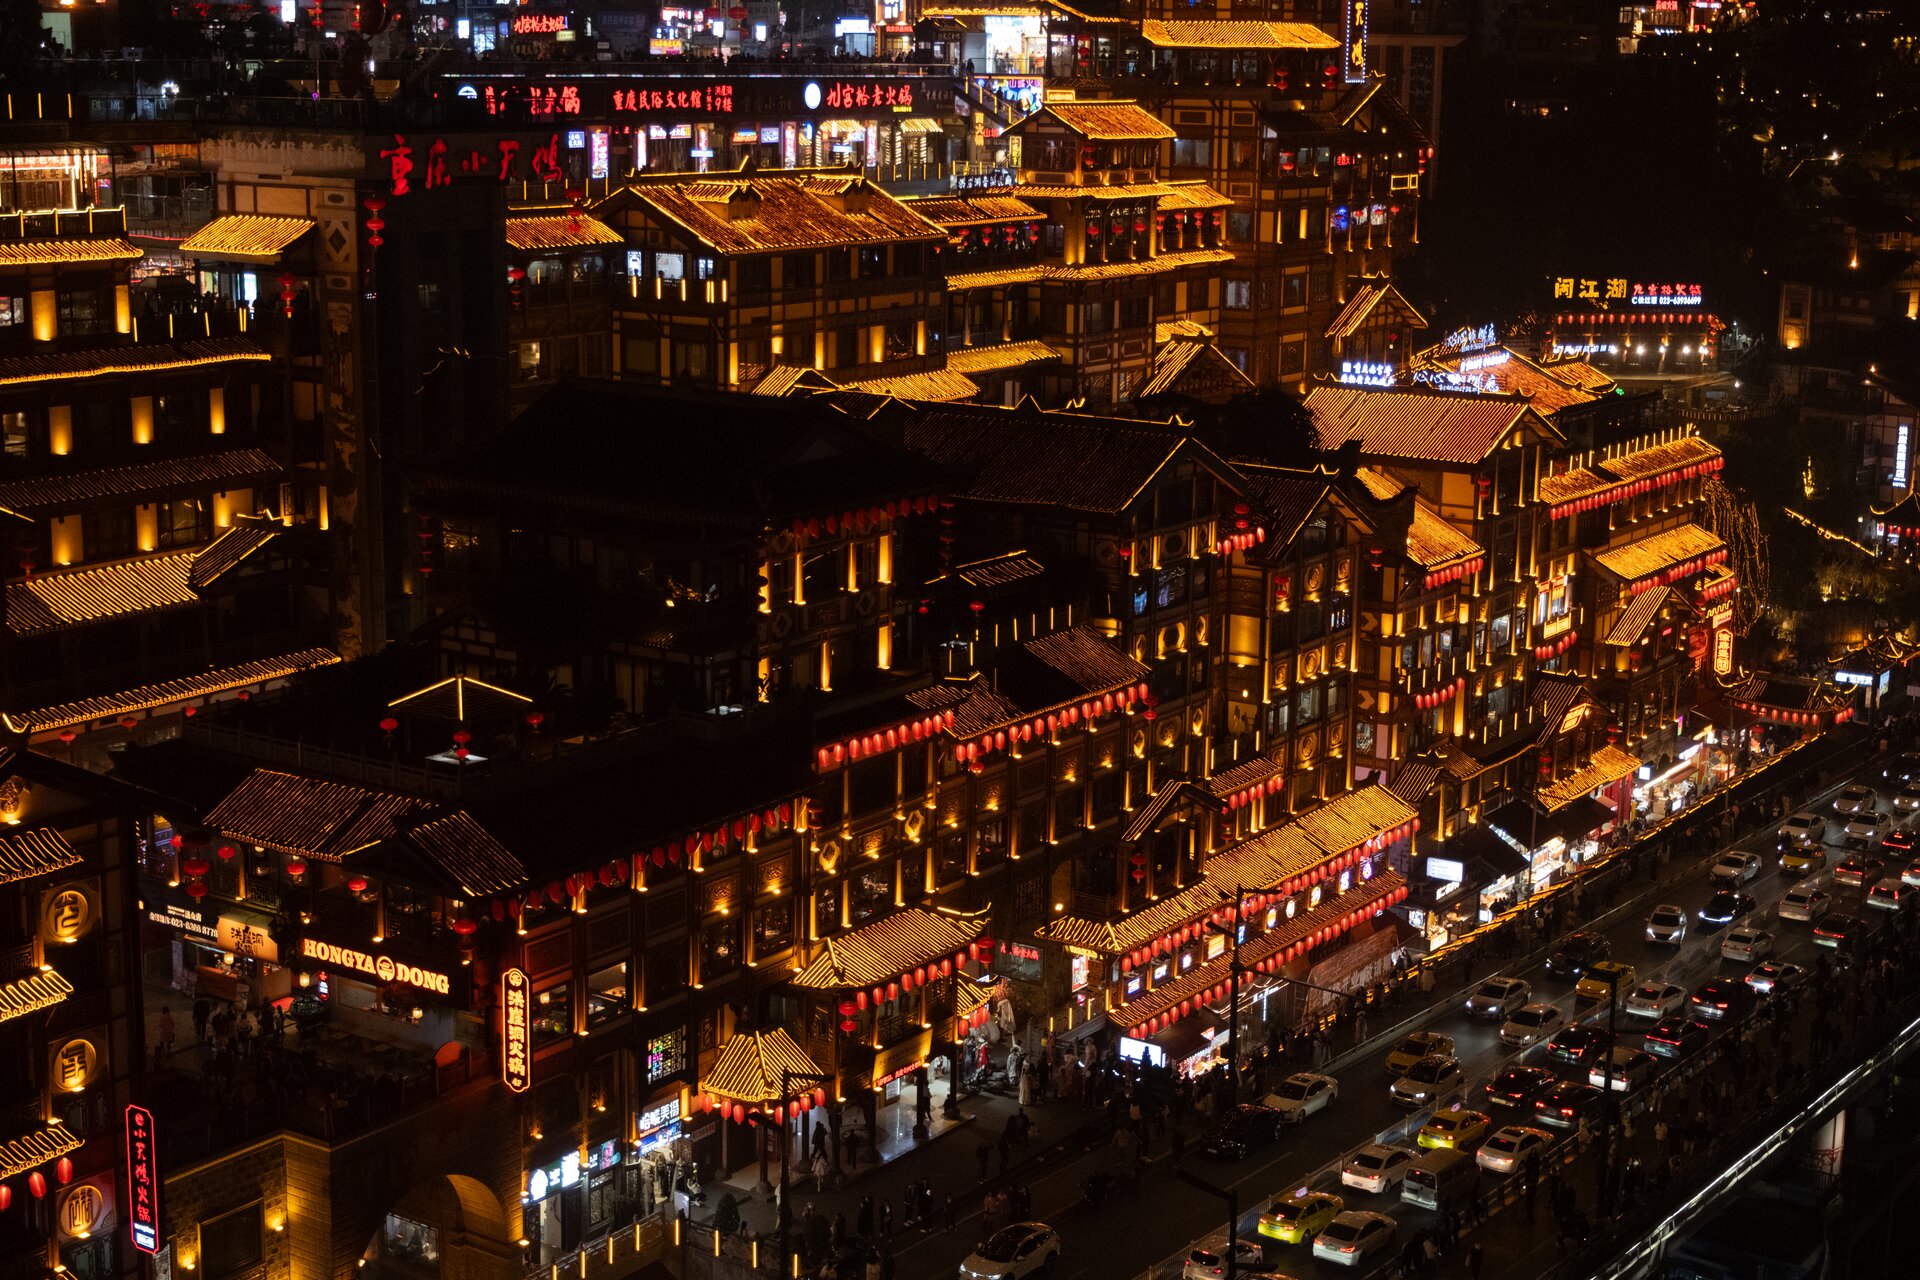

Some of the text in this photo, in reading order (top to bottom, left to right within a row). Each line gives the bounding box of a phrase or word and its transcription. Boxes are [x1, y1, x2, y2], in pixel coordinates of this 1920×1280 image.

[827, 82, 913, 109] 九宫格老火锅
[1554, 277, 1628, 299] 闹江湖
[1633, 283, 1702, 296] 九宫格火锅
[231, 925, 264, 948] 洪崖洞
[303, 938, 450, 995] HONGYA DONG
[507, 989, 526, 1077] 洪崖洞火锅
[134, 1128, 152, 1224] 小天鹅火锅
